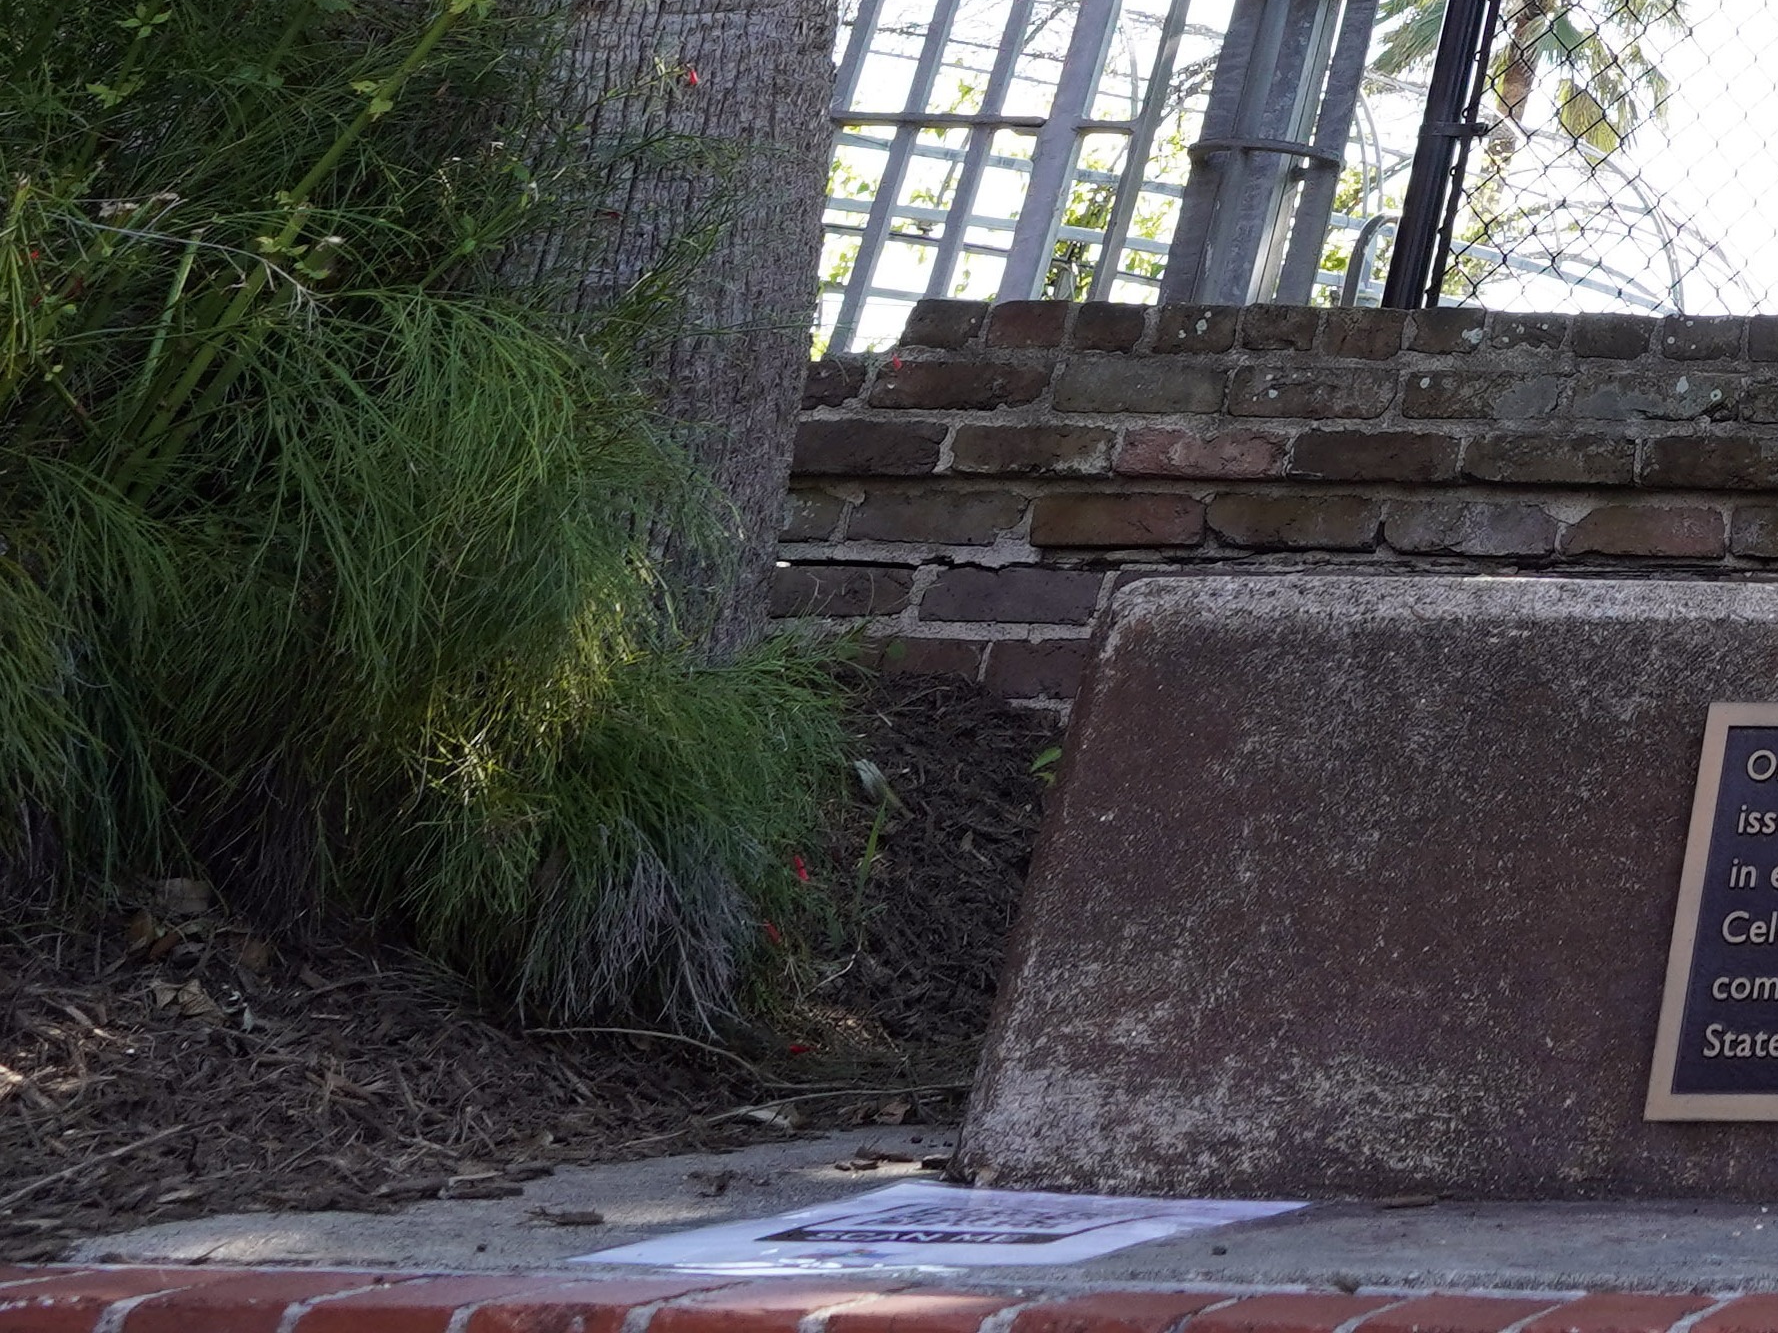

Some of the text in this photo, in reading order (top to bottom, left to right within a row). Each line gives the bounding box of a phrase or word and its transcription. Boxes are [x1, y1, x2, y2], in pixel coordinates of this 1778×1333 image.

[1728, 858, 1757, 889] in
[804, 1231, 1028, 1243] SCAN ME
